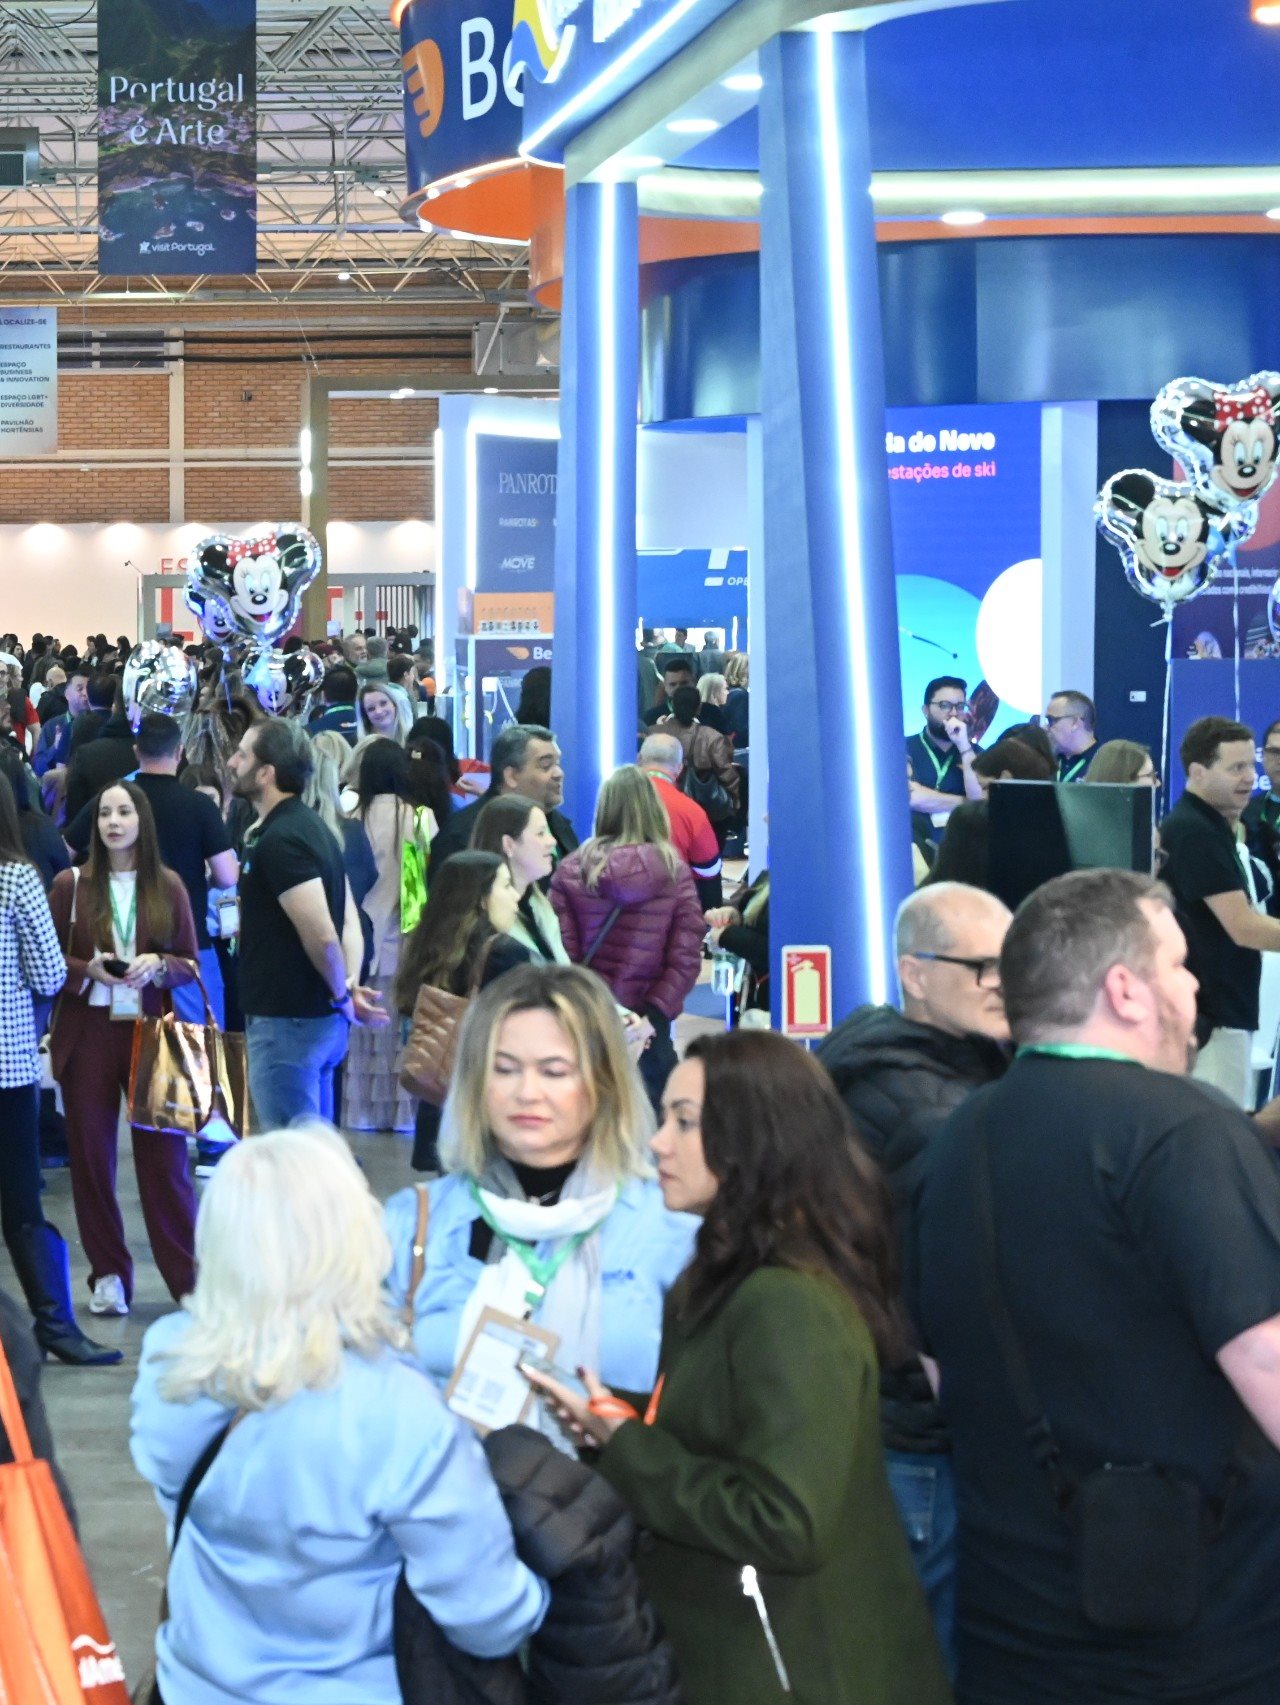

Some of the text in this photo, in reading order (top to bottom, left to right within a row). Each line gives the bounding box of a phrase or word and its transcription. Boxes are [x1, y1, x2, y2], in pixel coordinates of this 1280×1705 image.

[110, 73, 243, 111] Portugal
[130, 117, 224, 145] é Arte
[151, 242, 215, 256] visit Portugal
[0, 394, 27, 402] ESPAÇO
[952, 461, 972, 478] de
[974, 460, 997, 477] ski
[501, 557, 536, 569] MOVE
